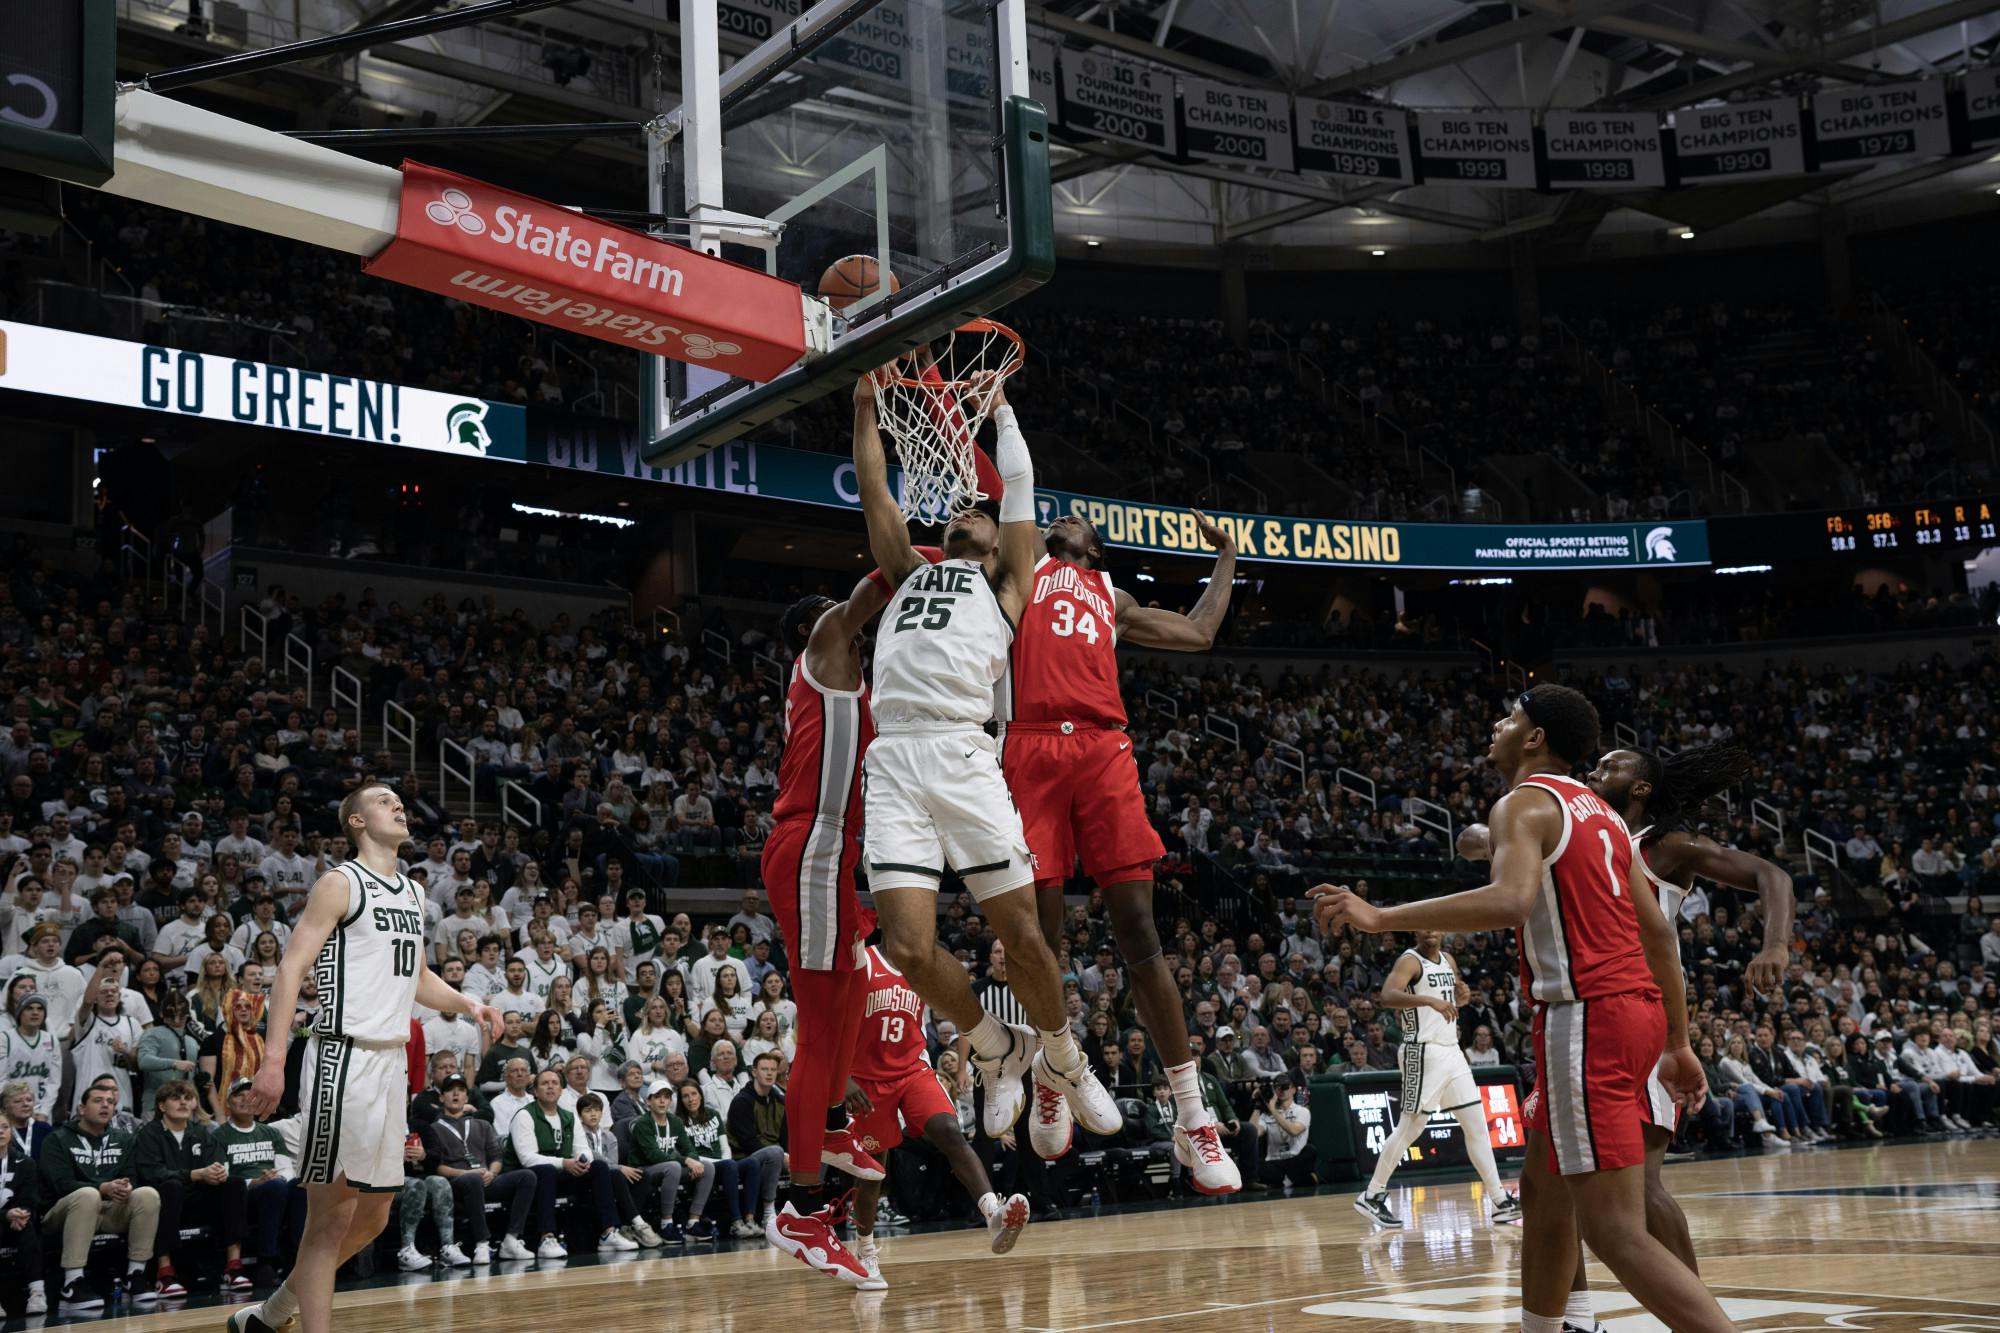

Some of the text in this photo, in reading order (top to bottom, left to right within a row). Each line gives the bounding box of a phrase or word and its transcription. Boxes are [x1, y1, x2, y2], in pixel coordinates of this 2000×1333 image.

[718, 8, 768, 37] 2010
[847, 45, 899, 76] 2009
[1076, 73, 1161, 104] TOURNAMENT
[1077, 88, 1163, 120] CHAMPIONS
[1206, 90, 1267, 113] BIG TEN
[1841, 91, 1917, 112] BIG TEN
[1093, 111, 1147, 140] 2000
[1189, 106, 1287, 133] CHAMPIONS
[1311, 120, 1394, 140] TOURNAMENT
[1442, 121, 1508, 135] BIG TEN
[1569, 121, 1634, 135] BIG TEN
[1700, 109, 1772, 130] BIG TEN
[1820, 105, 1943, 133] CHAMPIONS
[1214, 135, 1264, 157] 2000
[1312, 134, 1398, 154] CHAMPIONS
[1424, 138, 1530, 152] CHAMPIONS
[1551, 138, 1657, 152] CHAMPIONS
[1680, 124, 1798, 149] CHAMPIONS
[1858, 134, 1908, 154] 1979
[1332, 154, 1380, 175] 1999
[1456, 161, 1501, 177] 1999
[1584, 162, 1629, 179] 1998
[1715, 152, 1767, 172] 1990
[142, 345, 401, 443] GO GREEN!
[1955, 506, 1965, 522] R
[1980, 504, 1990, 520] A
[1264, 520, 1289, 557] &
[1293, 522, 1401, 562] CASINO
[1506, 536, 1628, 548] OFFICIAL SPORTS BETTING
[1476, 547, 1630, 558] PARTNER OF SPARTAN ATHLETICS
[895, 597, 955, 633] 25
[1051, 600, 1099, 645] 34
[1598, 829, 1620, 896] 1
[373, 907, 421, 935] STATE
[391, 938, 416, 977] 10
[881, 1017, 905, 1043] 13
[1359, 1109, 1383, 1124] STATE
[1496, 1117, 1517, 1144] 34
